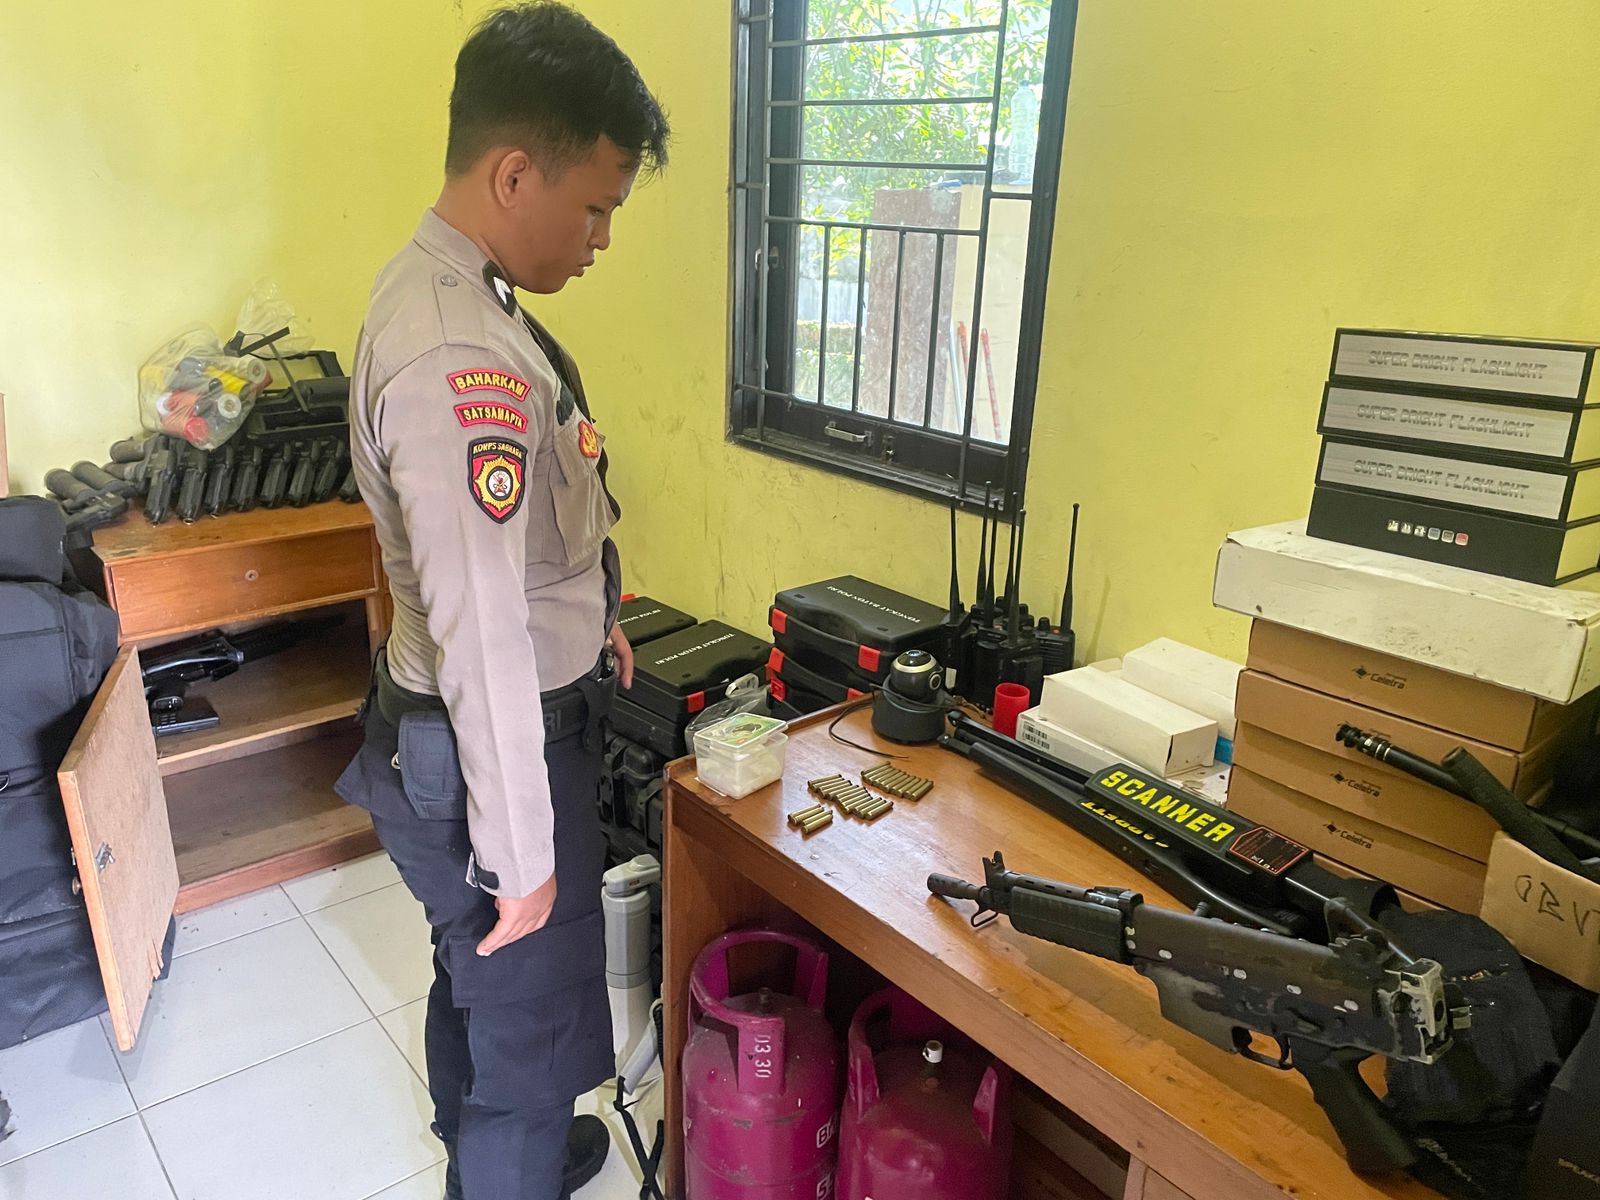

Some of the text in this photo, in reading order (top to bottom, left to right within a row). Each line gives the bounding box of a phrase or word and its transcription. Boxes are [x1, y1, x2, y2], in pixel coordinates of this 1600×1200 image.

[1368, 350, 1548, 380] SUPER BRIGHT FLASHLIGHT
[454, 372, 526, 396] BAHARKAM
[463, 406, 523, 428] SATSAMAPTA
[1356, 403, 1535, 438] SUPER BRIGHT FLASHLIGHT
[473, 442, 497, 454] KORPS
[1353, 459, 1530, 499] SUPER BRIGHT FLASHLIGHT
[1099, 770, 1237, 843] SCANNER
